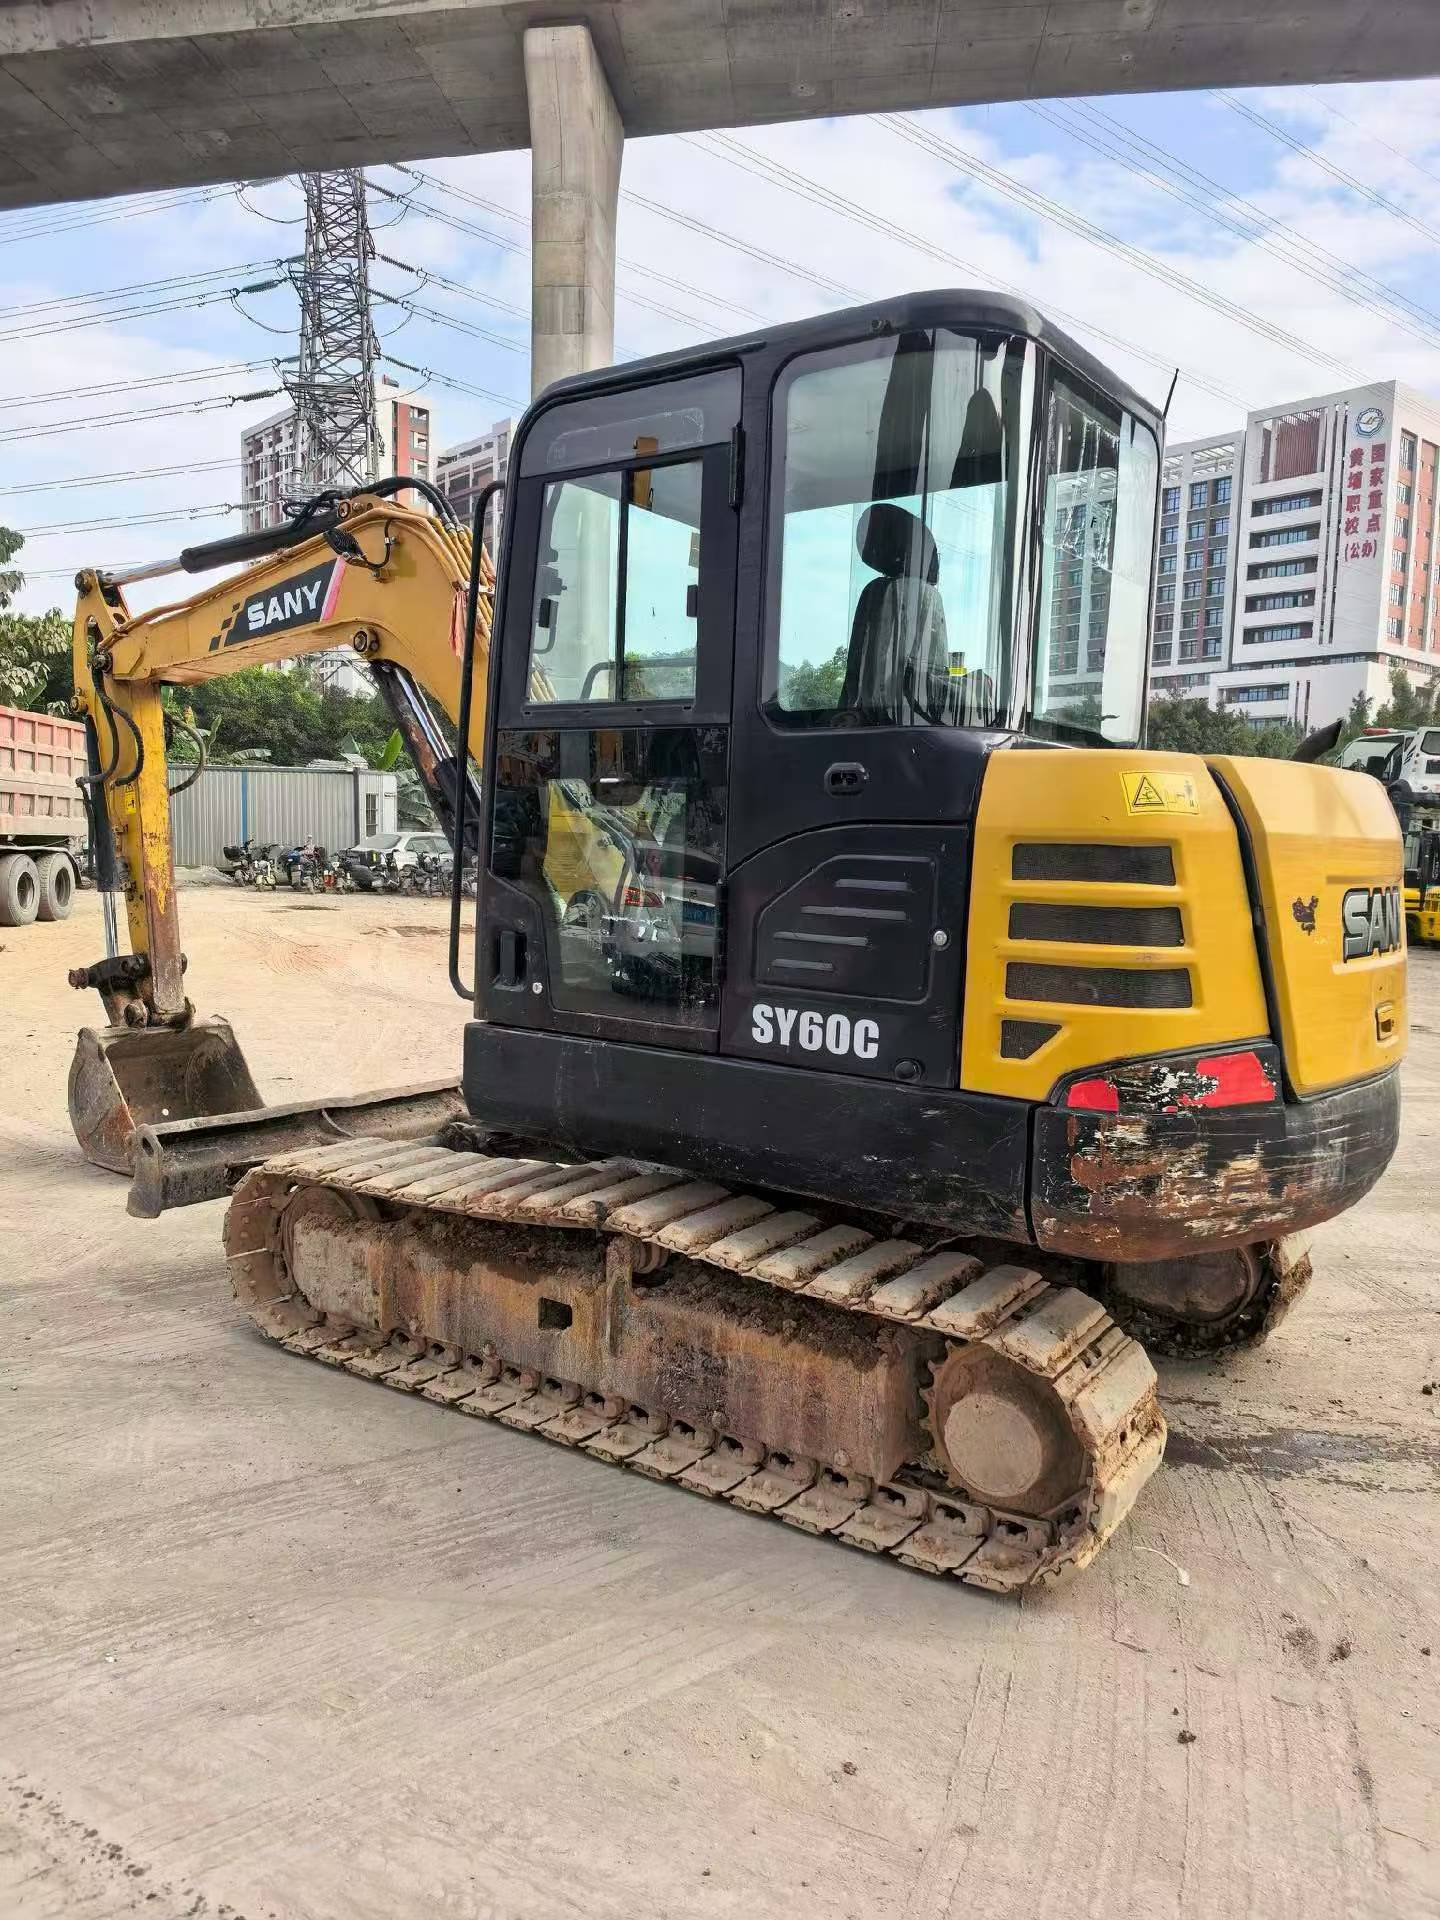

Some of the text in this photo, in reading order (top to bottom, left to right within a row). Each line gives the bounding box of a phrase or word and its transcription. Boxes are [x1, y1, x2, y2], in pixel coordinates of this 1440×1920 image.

[1367, 443, 1386, 533] 国家重点
[247, 580, 322, 631] SANY
[1342, 887, 1401, 963] SAN
[751, 1003, 880, 1059] SY60C
